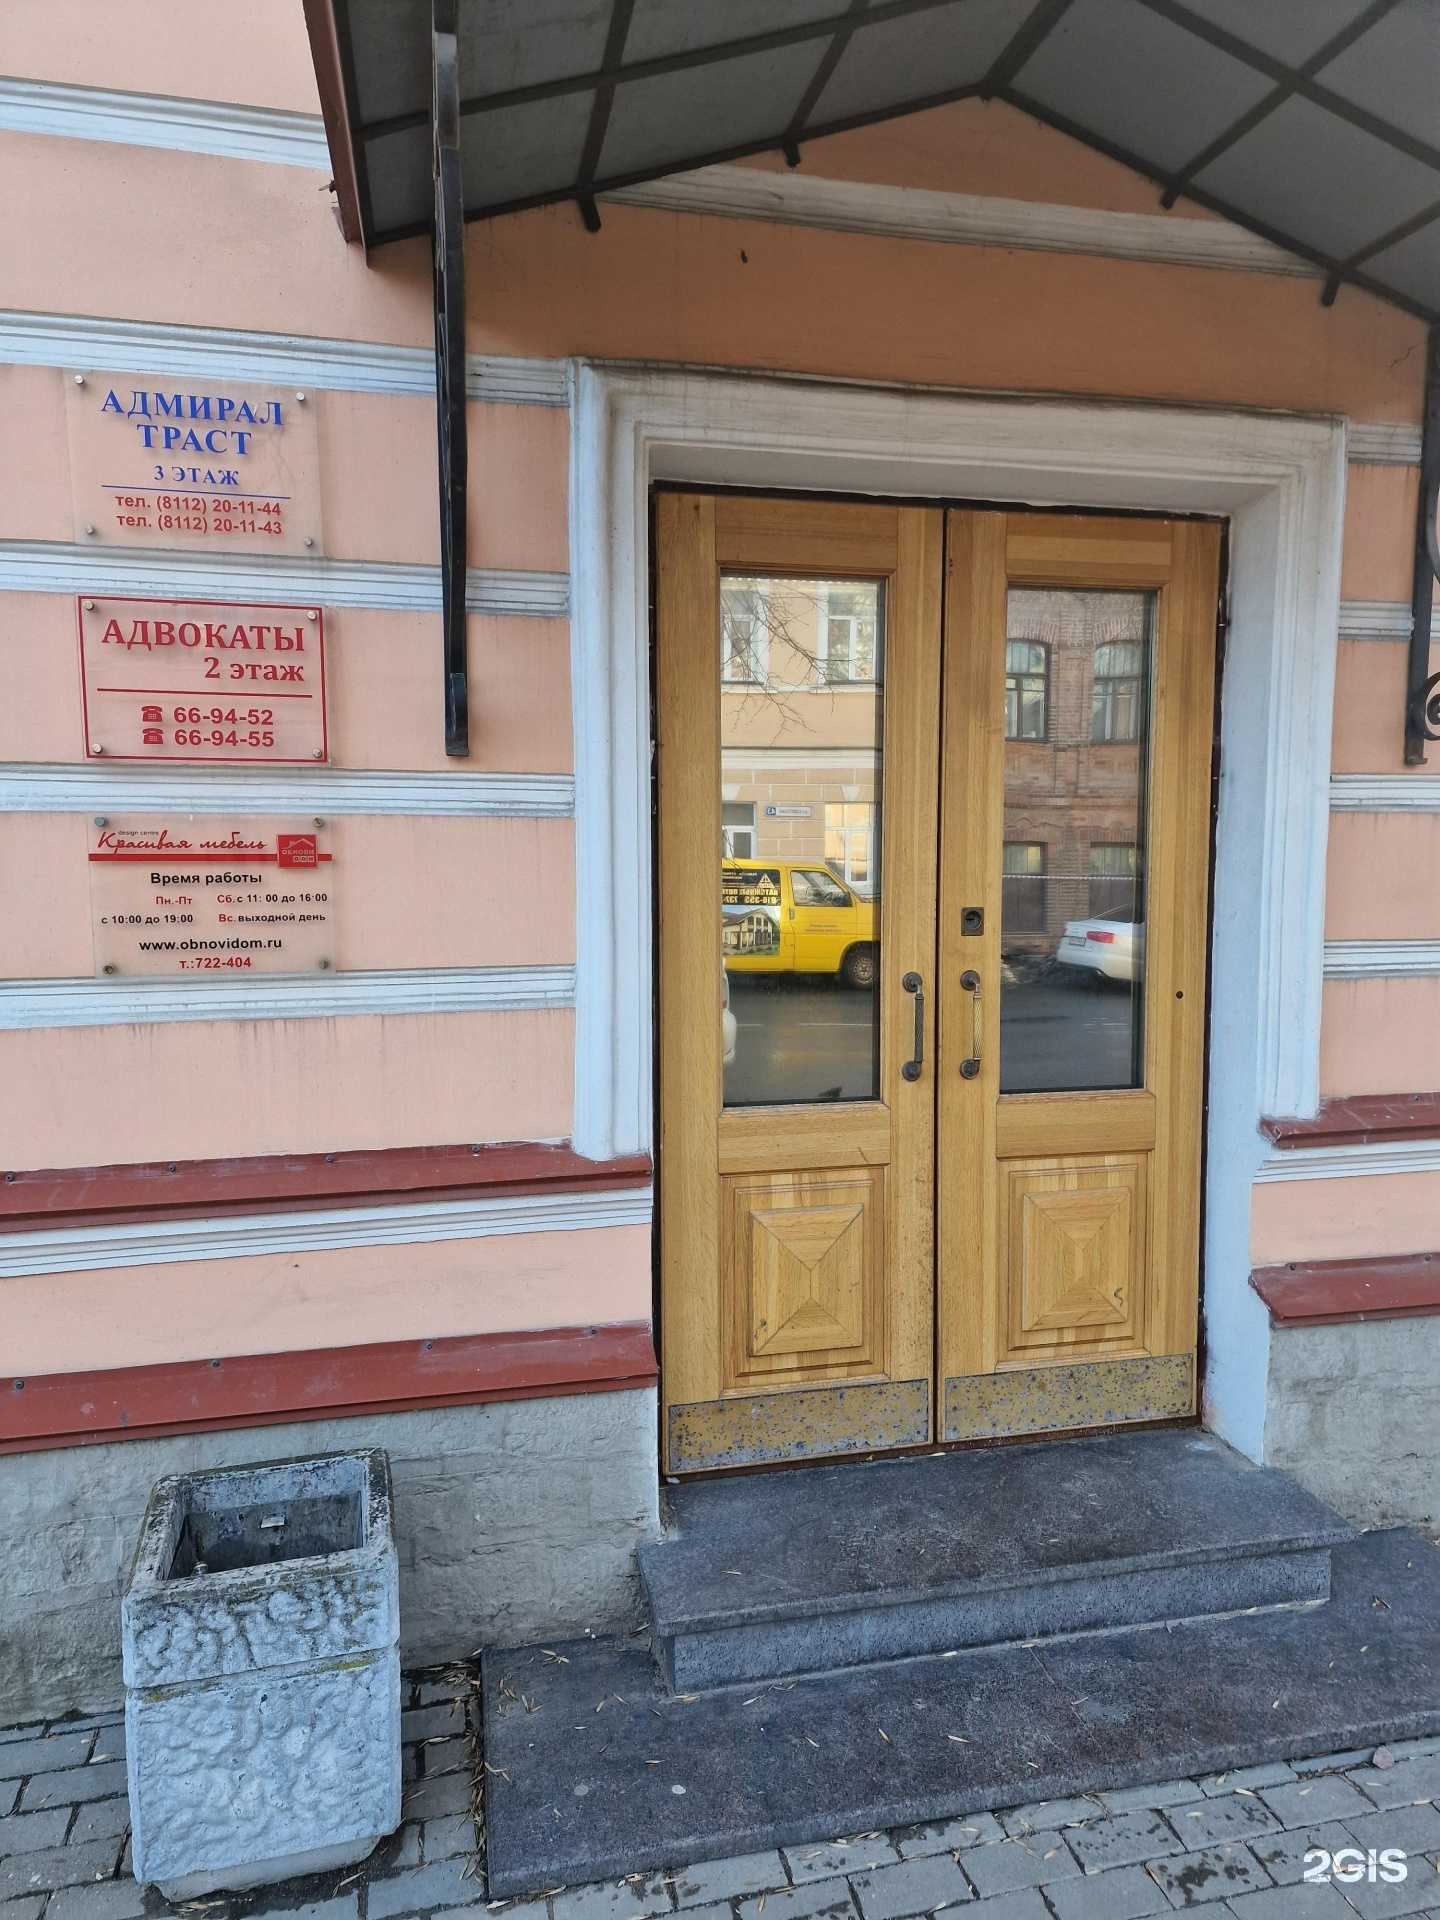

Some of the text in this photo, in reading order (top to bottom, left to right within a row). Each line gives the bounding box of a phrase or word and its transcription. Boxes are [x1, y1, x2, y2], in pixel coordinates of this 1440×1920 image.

[101, 389, 284, 426] АДМИРАЛ
[136, 423, 252, 455] ТРАСТ
[153, 465, 240, 486] 3 ЭТАЖ
[115, 495, 282, 516] тел. (8112) 20-11-44
[116, 514, 283, 535] тел. (8112) 20-11-43
[101, 619, 305, 651] АДВОКАТЫ
[204, 656, 305, 682] 2 этаж
[173, 706, 274, 726] 66-94-52
[174, 729, 275, 747] 66-94-55
[97, 829, 268, 855] Красивая мебель
[150, 871, 263, 886] Время работы
[281, 895, 296, 904] до
[299, 893, 328, 902] 16:00
[101, 914, 194, 925] с 10:00 до 19:00
[238, 913, 296, 923] выходной
[298, 914, 326, 923] день
[139, 938, 282, 951] www.obnovidom.ru
